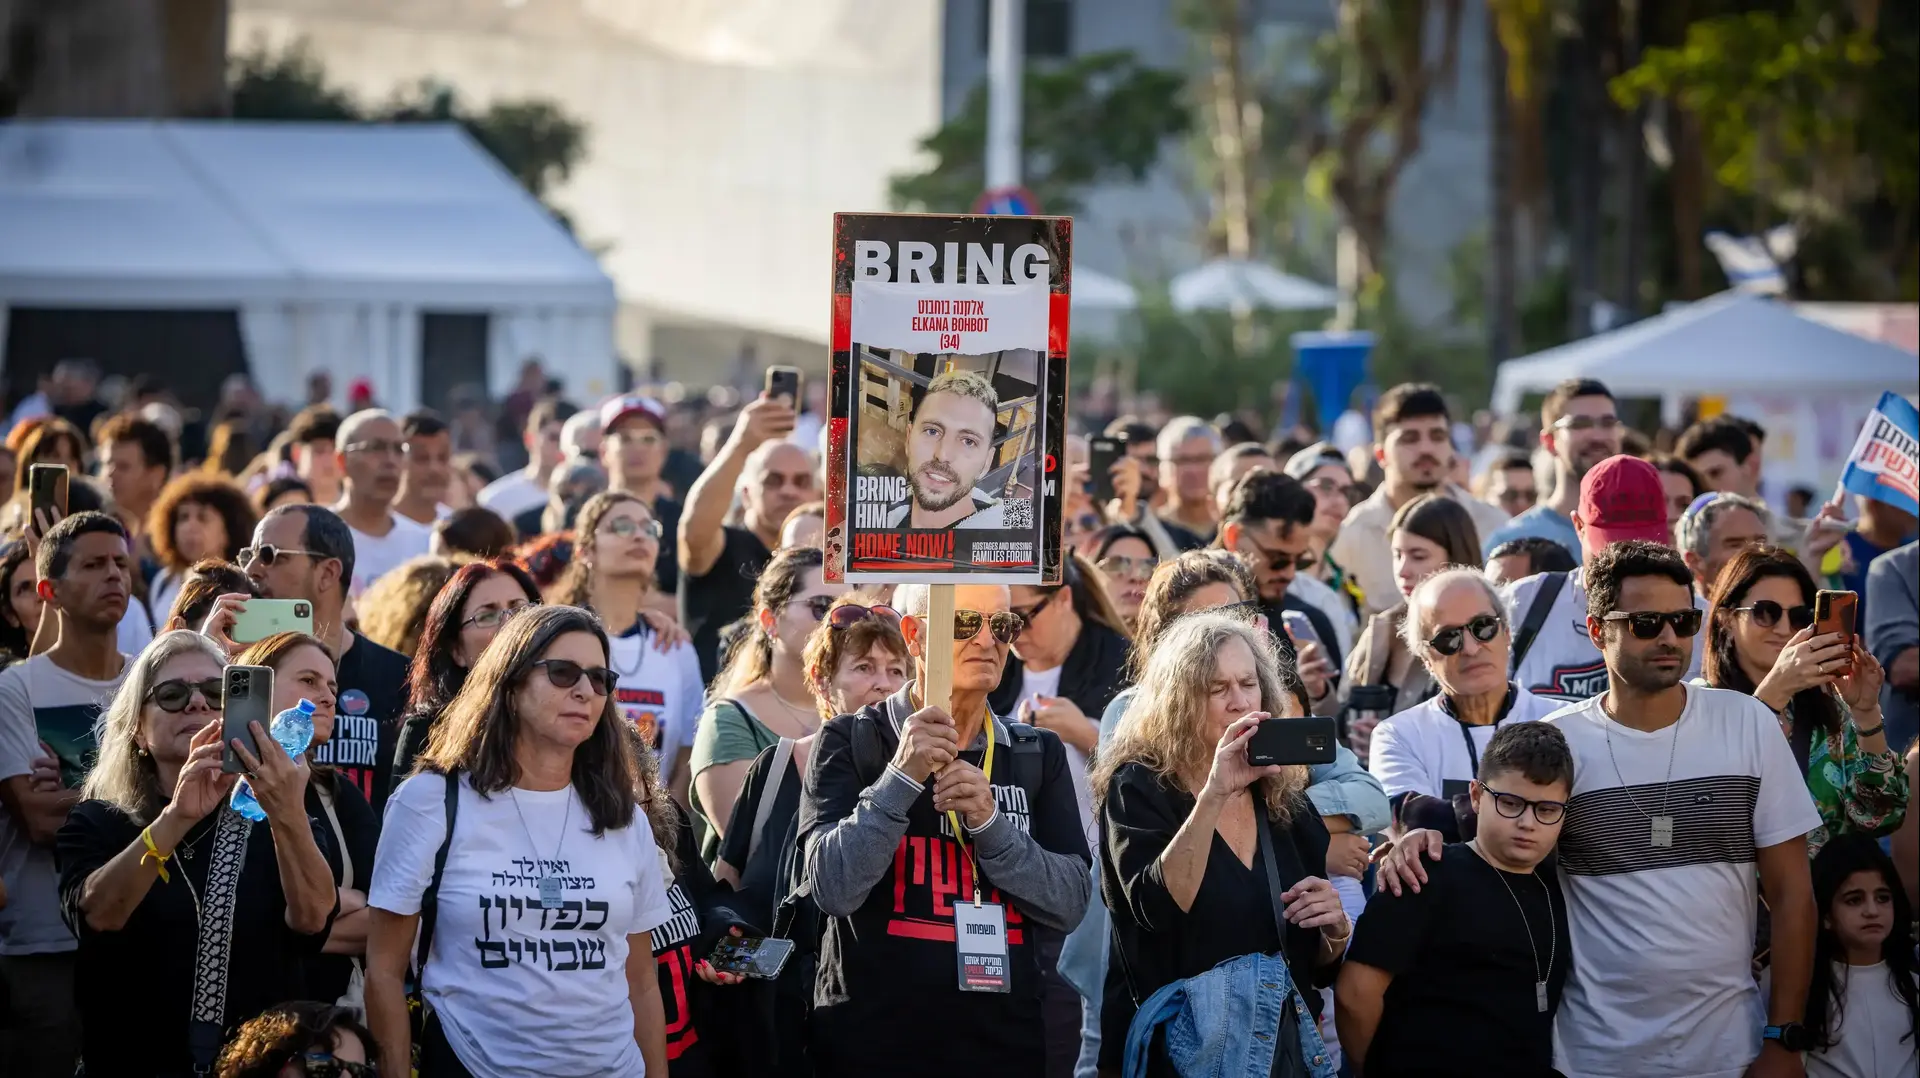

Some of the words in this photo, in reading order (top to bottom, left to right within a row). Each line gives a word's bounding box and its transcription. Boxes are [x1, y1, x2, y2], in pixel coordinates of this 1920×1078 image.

[855, 240, 1050, 285] BRING
[918, 300, 950, 314] בוחבוט
[953, 300, 984, 316] אלקנה
[912, 317, 949, 331] ELKANA
[952, 318, 989, 332] BOHBOT
[940, 334, 960, 350] (34)
[856, 476, 906, 502] BRING
[855, 504, 887, 528] HIM
[854, 533, 901, 558] HOME
[906, 530, 954, 559] NOW!
[972, 542, 998, 551] HOSTAGES
[972, 551, 1005, 562] FAMILIES
[1006, 551, 1032, 562] FORUM
[338, 739, 377, 766] אותם
[512, 856, 534, 878] לך
[536, 859, 570, 878] ואין
[479, 894, 609, 942] כפדיון
[966, 923, 996, 935] משפחות
[475, 936, 606, 971] שבויים
